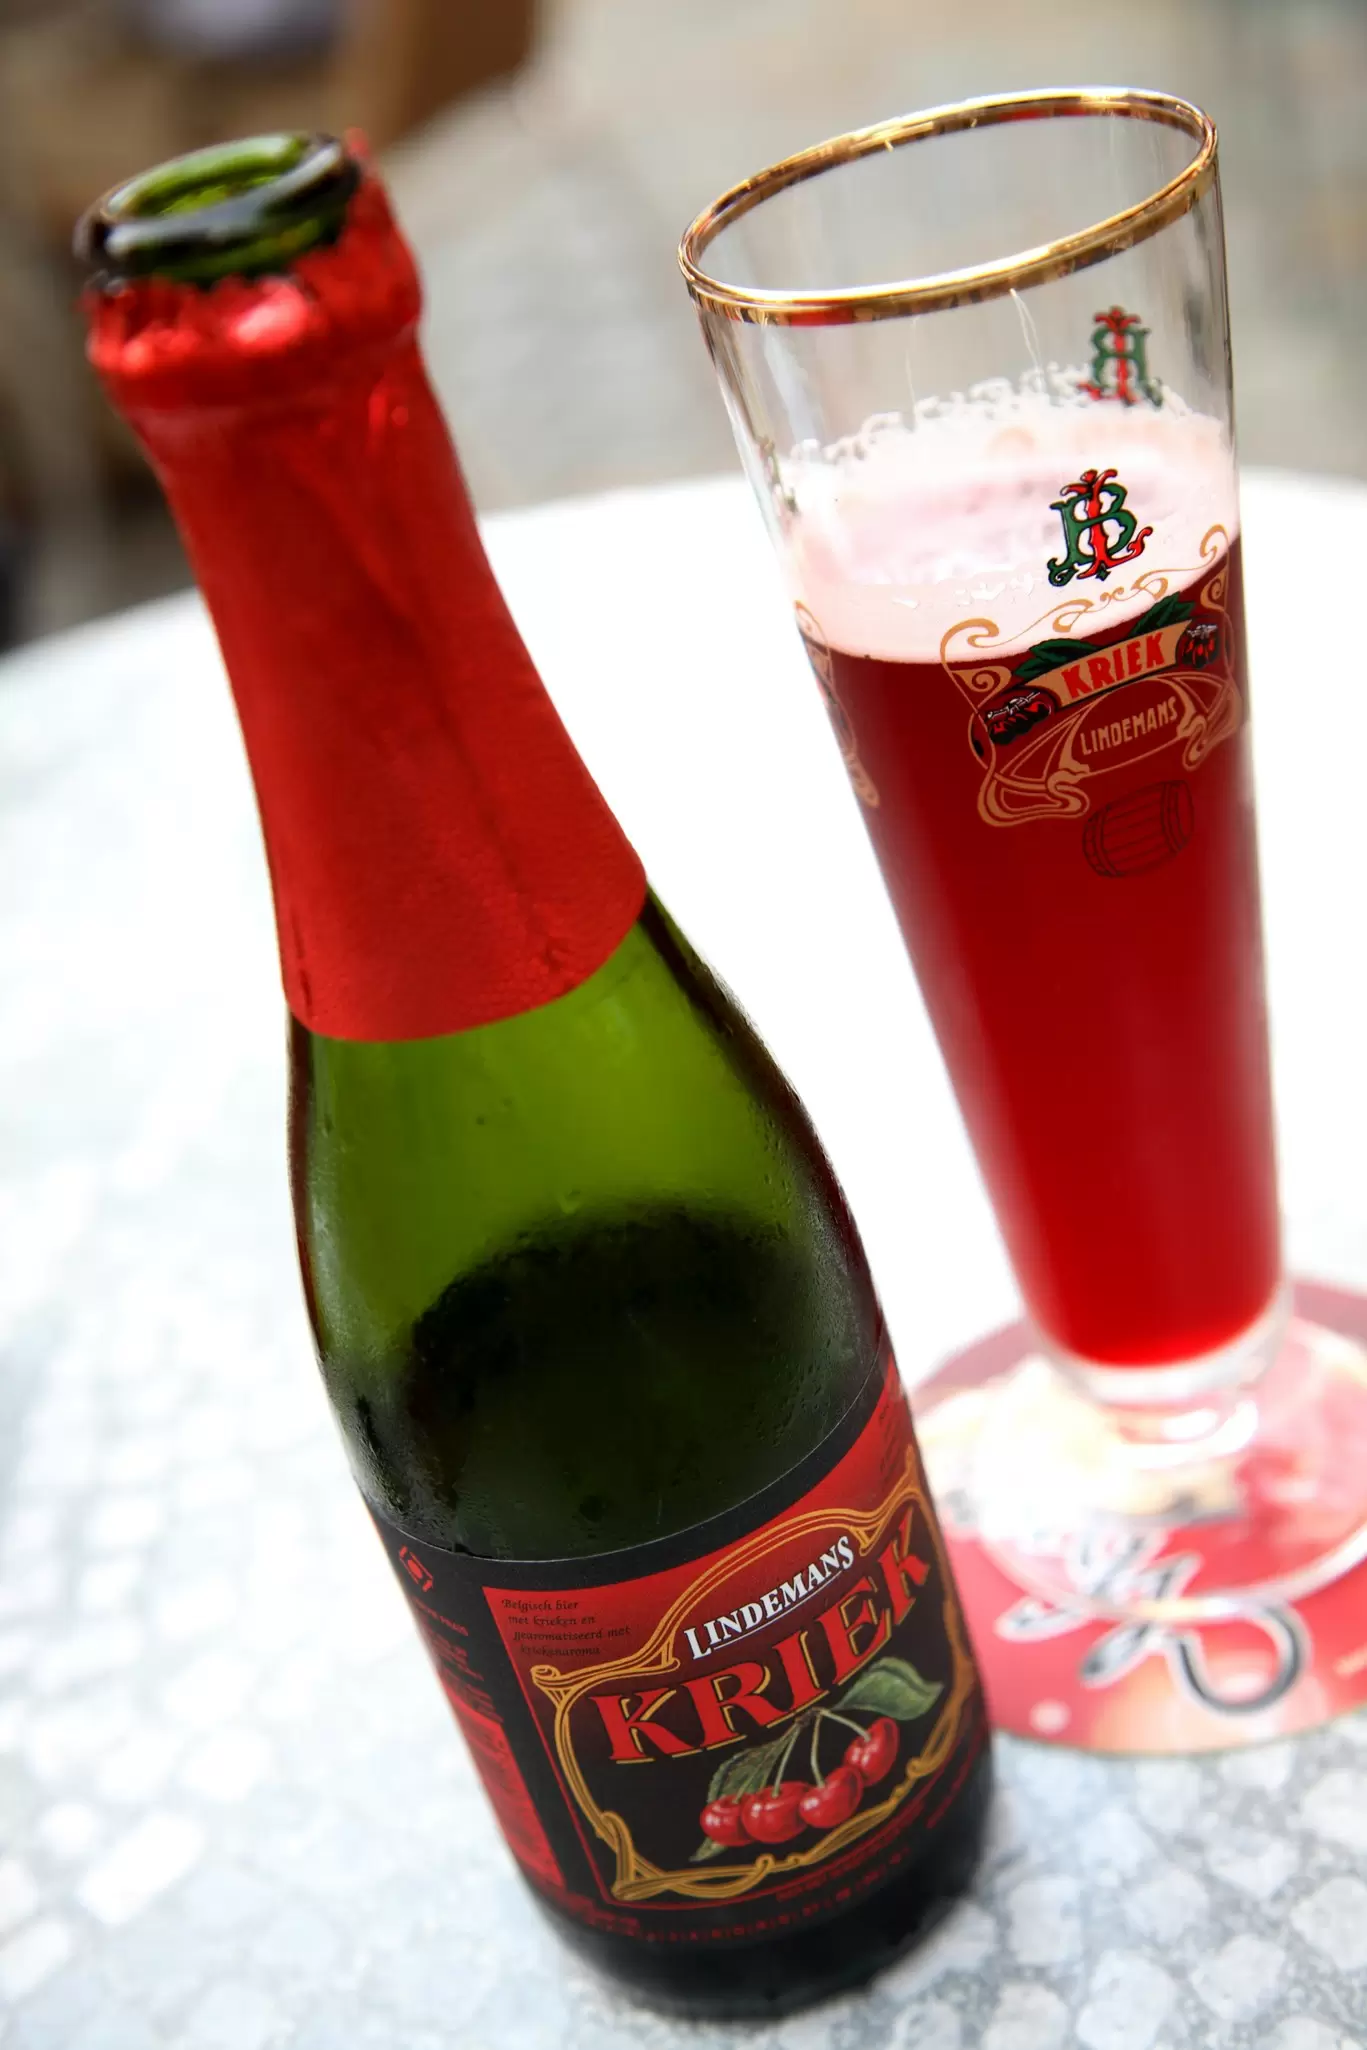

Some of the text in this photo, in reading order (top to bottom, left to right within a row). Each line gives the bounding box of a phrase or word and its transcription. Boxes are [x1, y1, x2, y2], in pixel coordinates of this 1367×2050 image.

[1061, 632, 1166, 700] KRIEK
[1080, 696, 1178, 755] LINDEMANS
[502, 1599, 578, 1613] Belgisch bier
[508, 1615, 596, 1627] met krieken en
[684, 1535, 854, 1660] LINDEMANS
[513, 1625, 632, 1641] gearomatiseerd met
[589, 1506, 930, 1764] KRIEK
